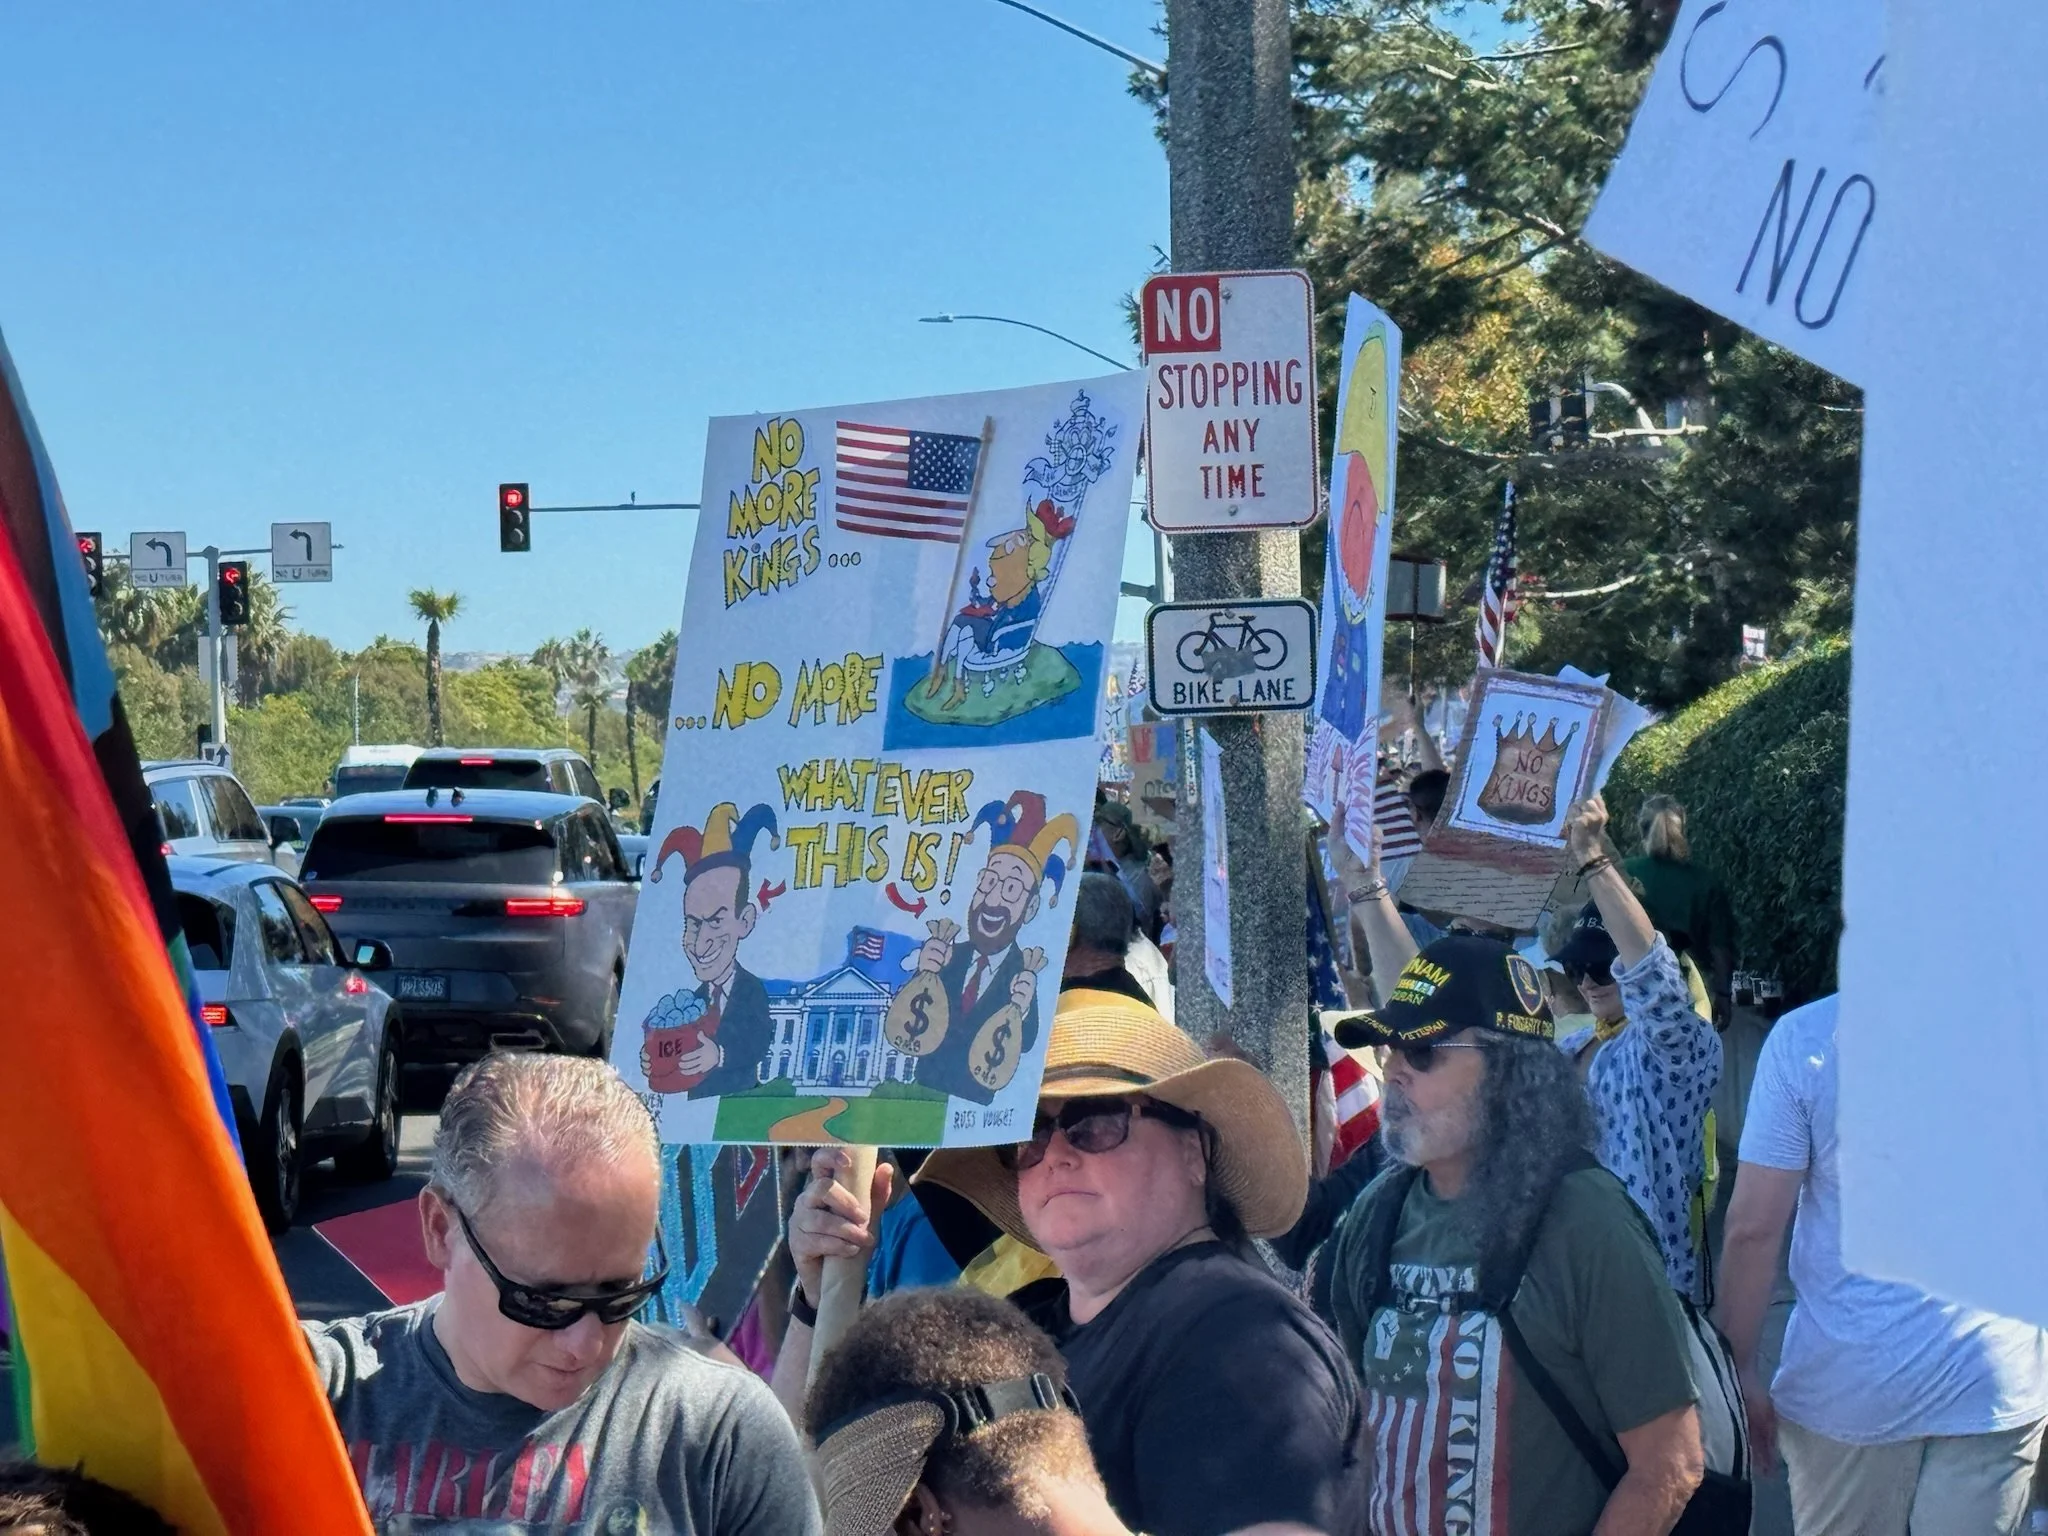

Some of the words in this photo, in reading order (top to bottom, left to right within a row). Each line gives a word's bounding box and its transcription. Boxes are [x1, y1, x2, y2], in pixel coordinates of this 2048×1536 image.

[1736, 158, 1876, 329] NO
[1156, 287, 1216, 343] NO
[1158, 359, 1303, 409] STOPPING
[752, 417, 805, 483] NO
[1203, 419, 1260, 454] ANY
[1200, 464, 1265, 499] TIME
[727, 468, 820, 539] MORE
[149, 571, 158, 582] U
[292, 568, 301, 579] U
[789, 653, 884, 728] MORE
[1173, 681, 1225, 705] BIKE
[1239, 678, 1295, 703] LANE
[1514, 750, 1543, 774] NO
[776, 757, 974, 825] WHATEVER
[786, 823, 890, 890] THIS
[658, 1039, 683, 1058] ICE
[953, 1111, 977, 1130] RUSS
